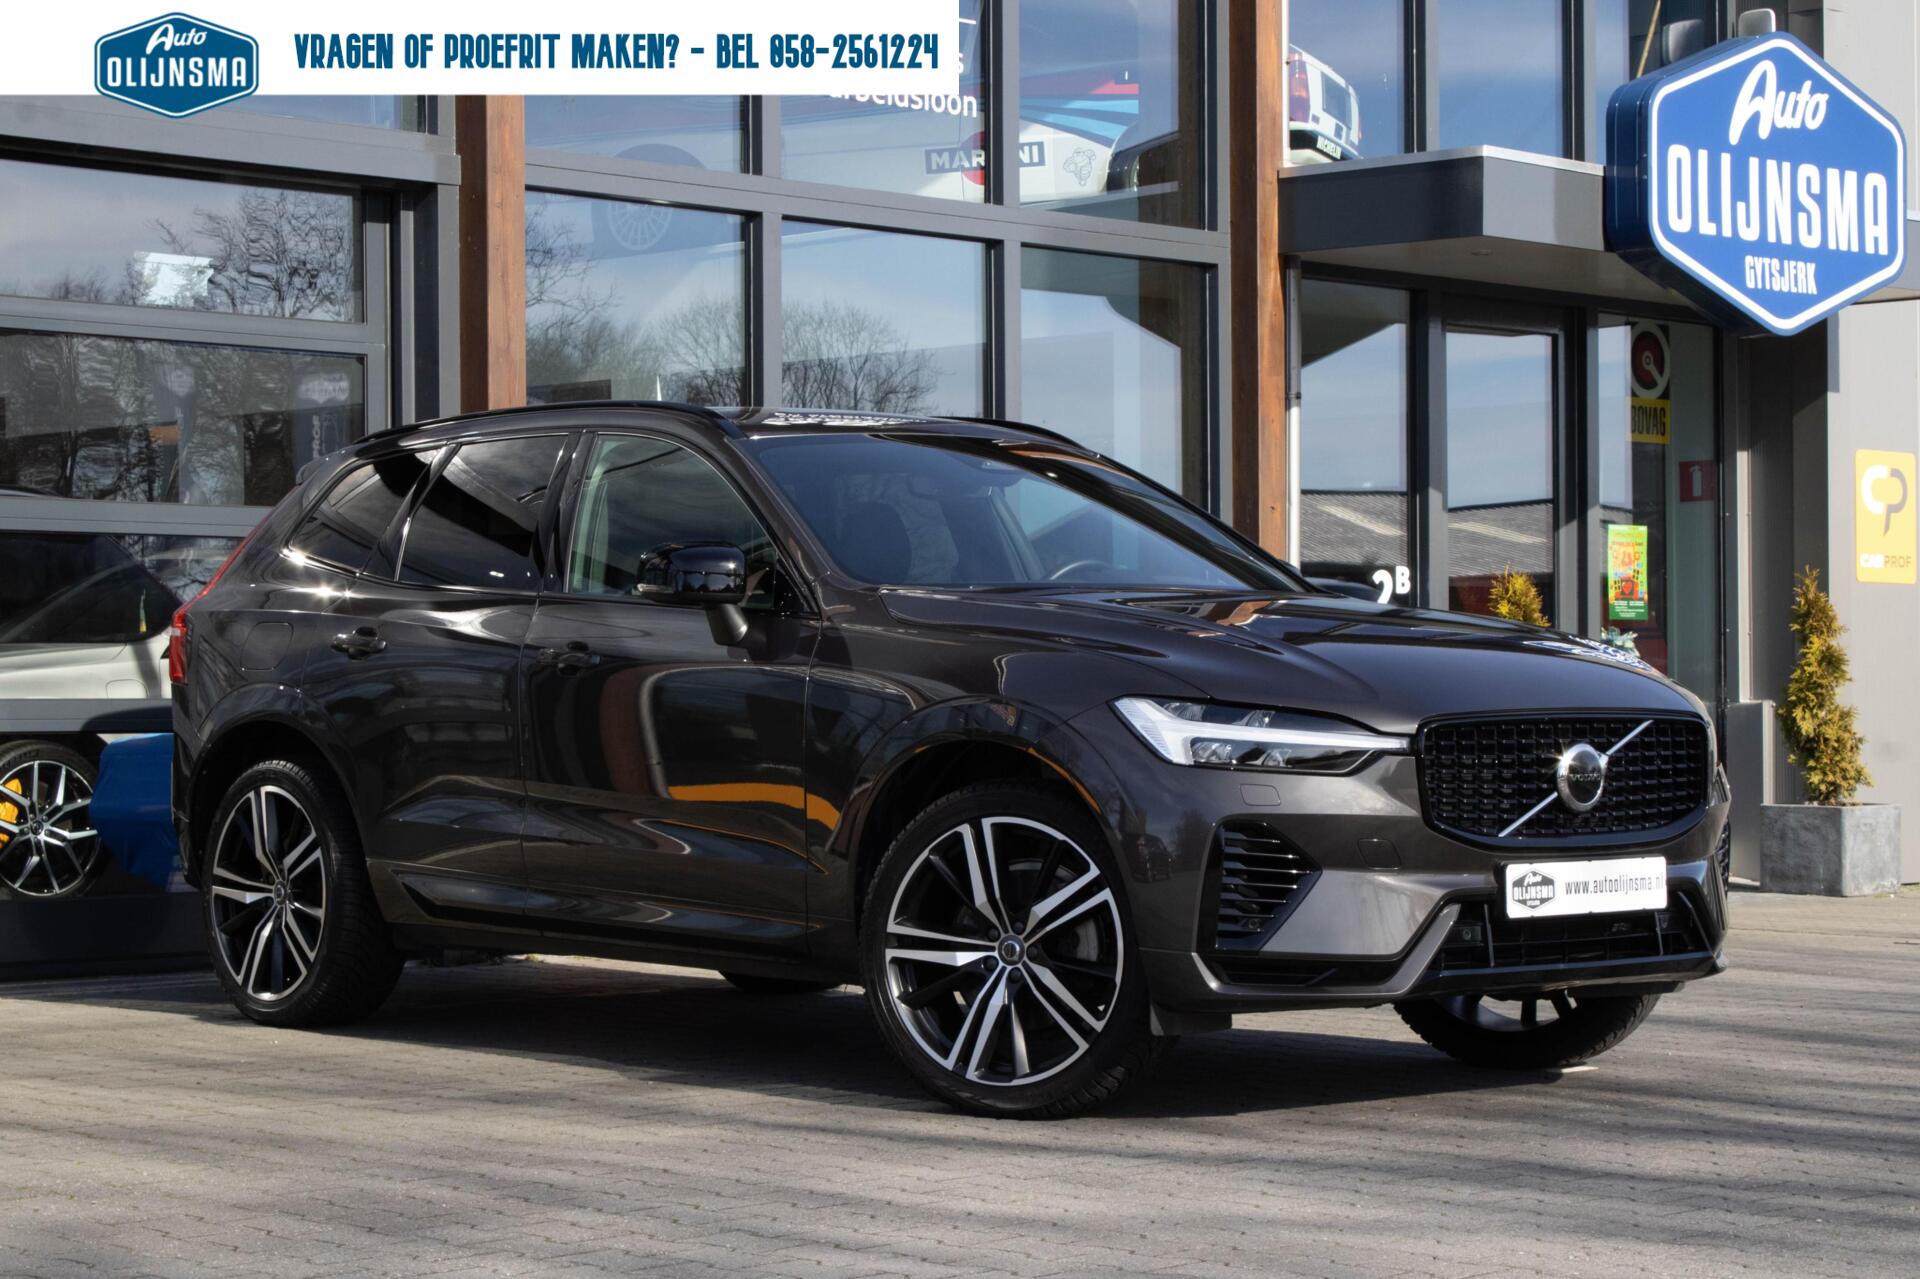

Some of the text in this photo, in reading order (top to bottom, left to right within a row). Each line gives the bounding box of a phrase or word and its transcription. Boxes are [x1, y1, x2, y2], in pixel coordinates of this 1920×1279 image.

[1728, 59, 1830, 146] Auto
[930, 144, 1040, 170] MARNI
[1667, 143, 1889, 256] OLIJNSMA
[1744, 255, 1818, 295] GYTSJERK
[1630, 405, 1667, 436] BOVAG
[1564, 873, 1664, 896] www.autoolijnsma.nl
